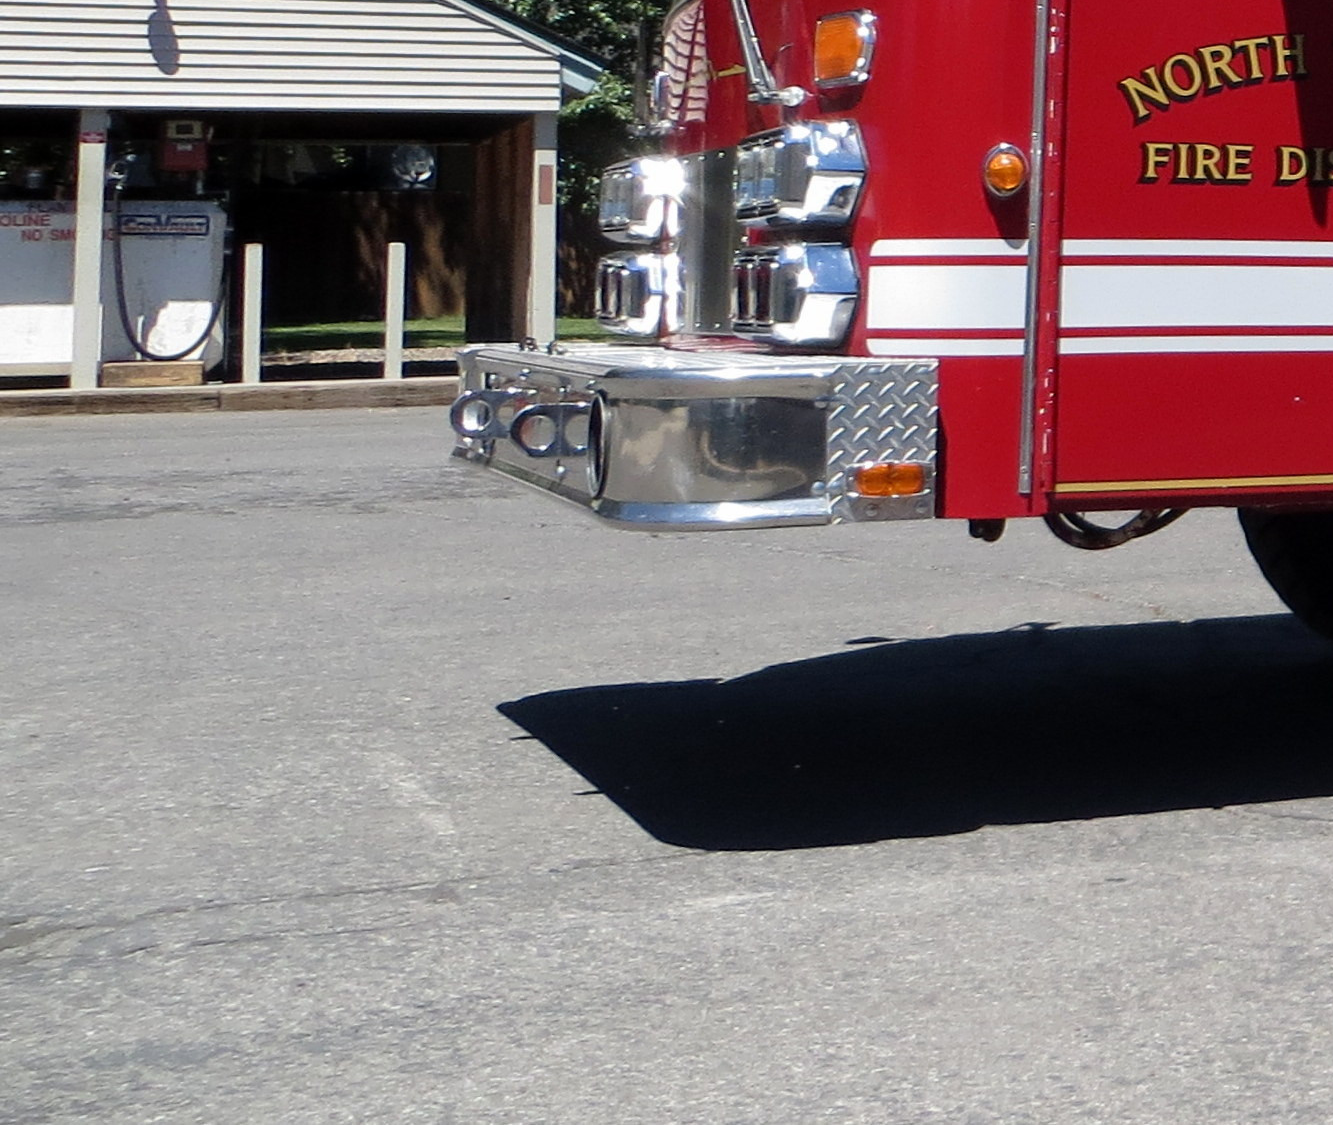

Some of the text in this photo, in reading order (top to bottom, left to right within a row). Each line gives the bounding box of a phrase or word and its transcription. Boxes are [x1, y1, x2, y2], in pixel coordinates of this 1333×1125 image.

[1118, 33, 1306, 121] NORTH
[1142, 142, 1254, 182] FIRE
[21, 228, 43, 241] NO
